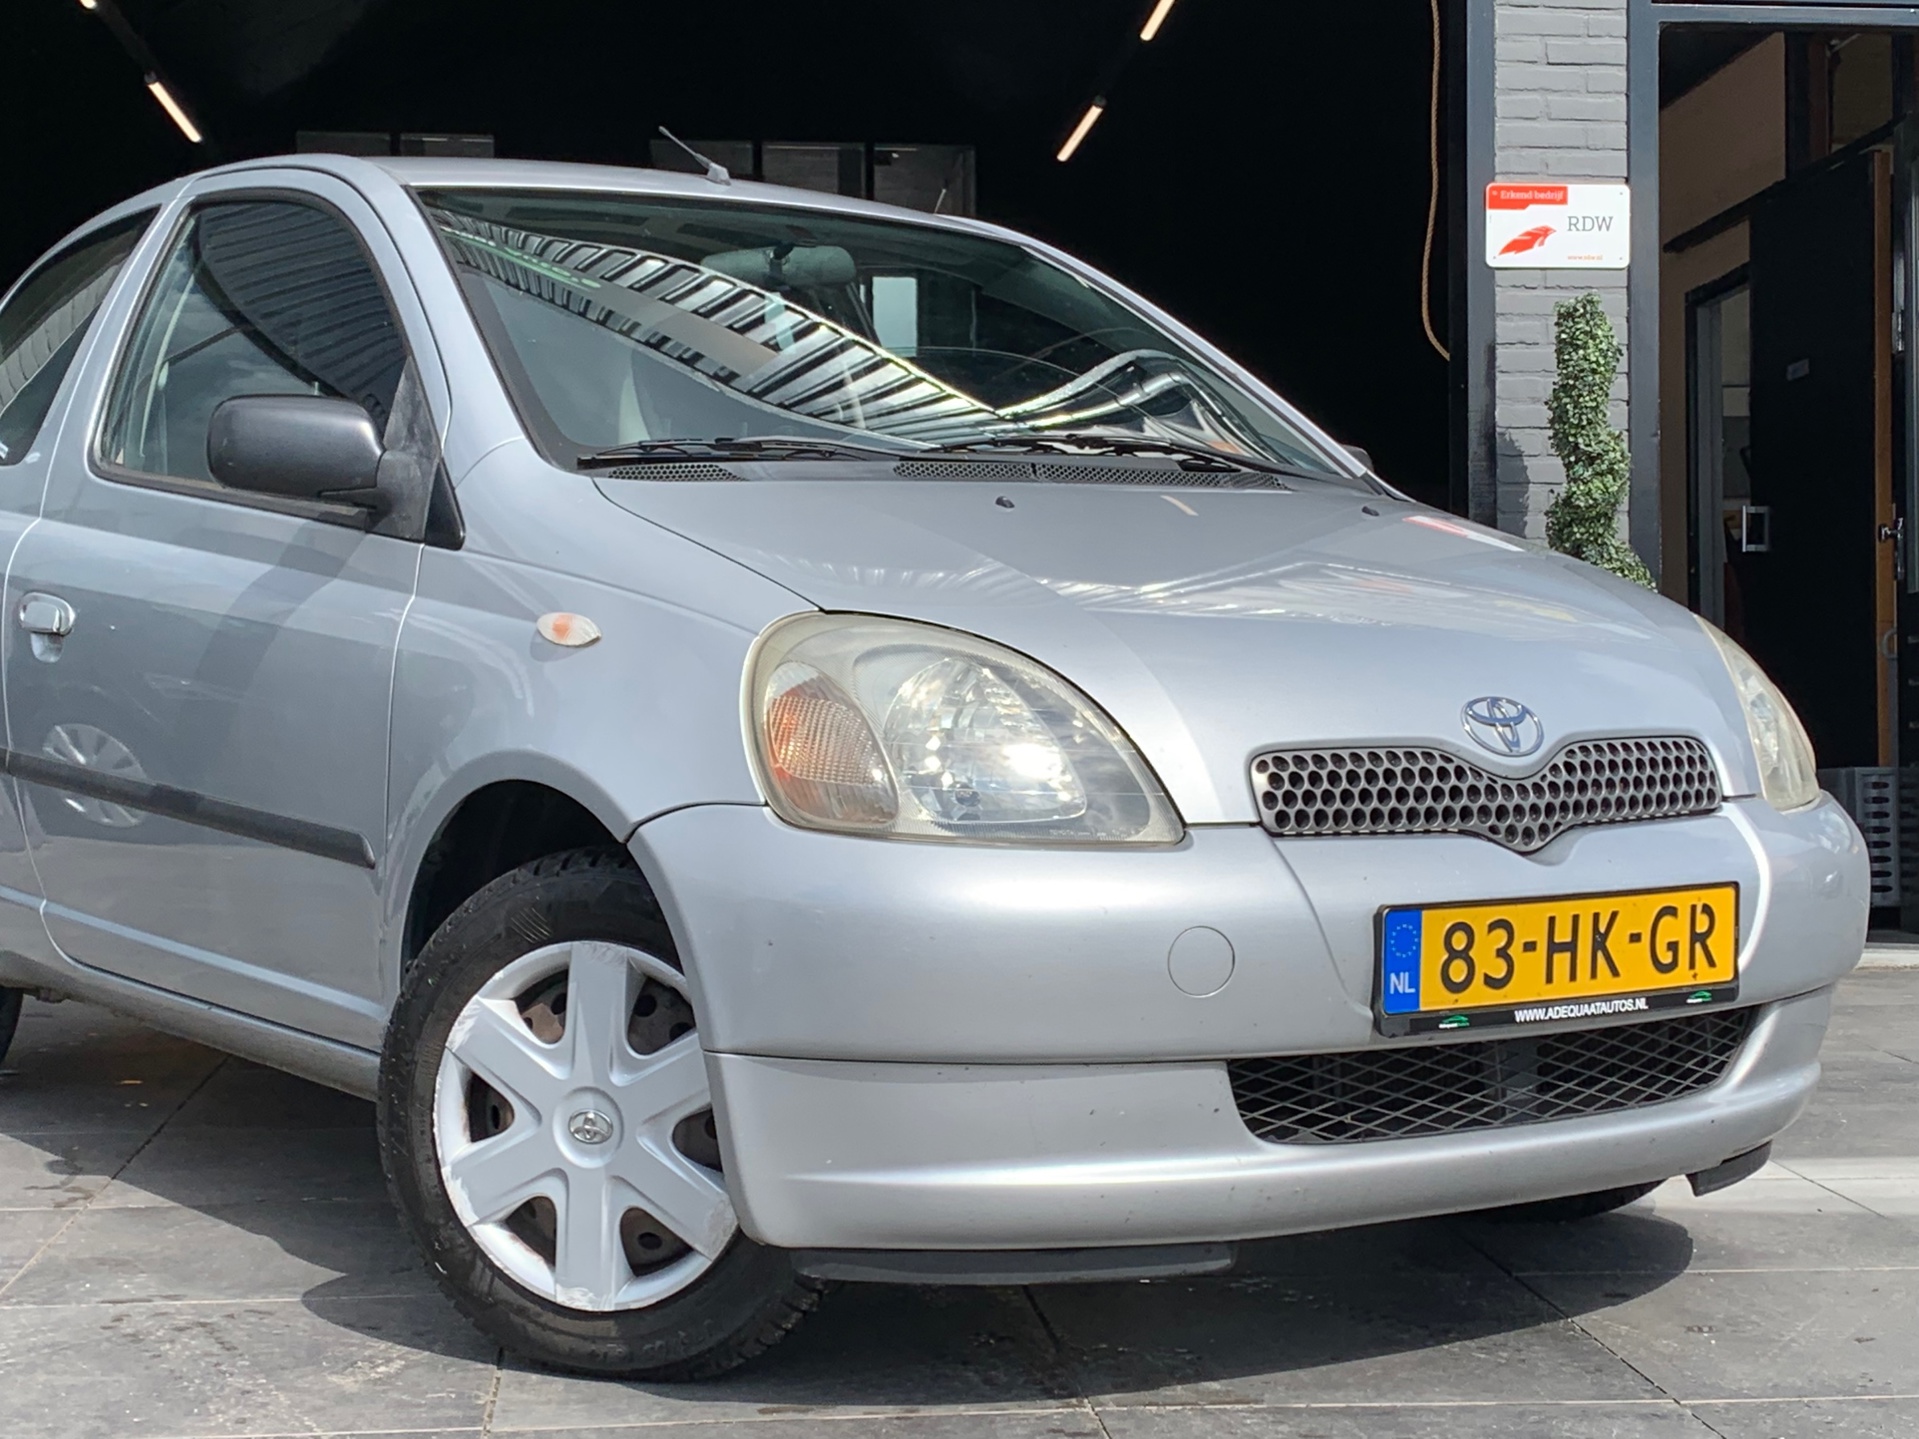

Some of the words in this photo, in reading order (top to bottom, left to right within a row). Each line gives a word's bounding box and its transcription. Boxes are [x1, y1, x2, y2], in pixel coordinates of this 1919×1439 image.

[1567, 216, 1613, 232] RDW
[1440, 902, 1717, 995] 83-HK-GR
[1389, 972, 1416, 995] NL
[1514, 998, 1648, 1023] WWW.ADEQUAATAUTOS.NL
